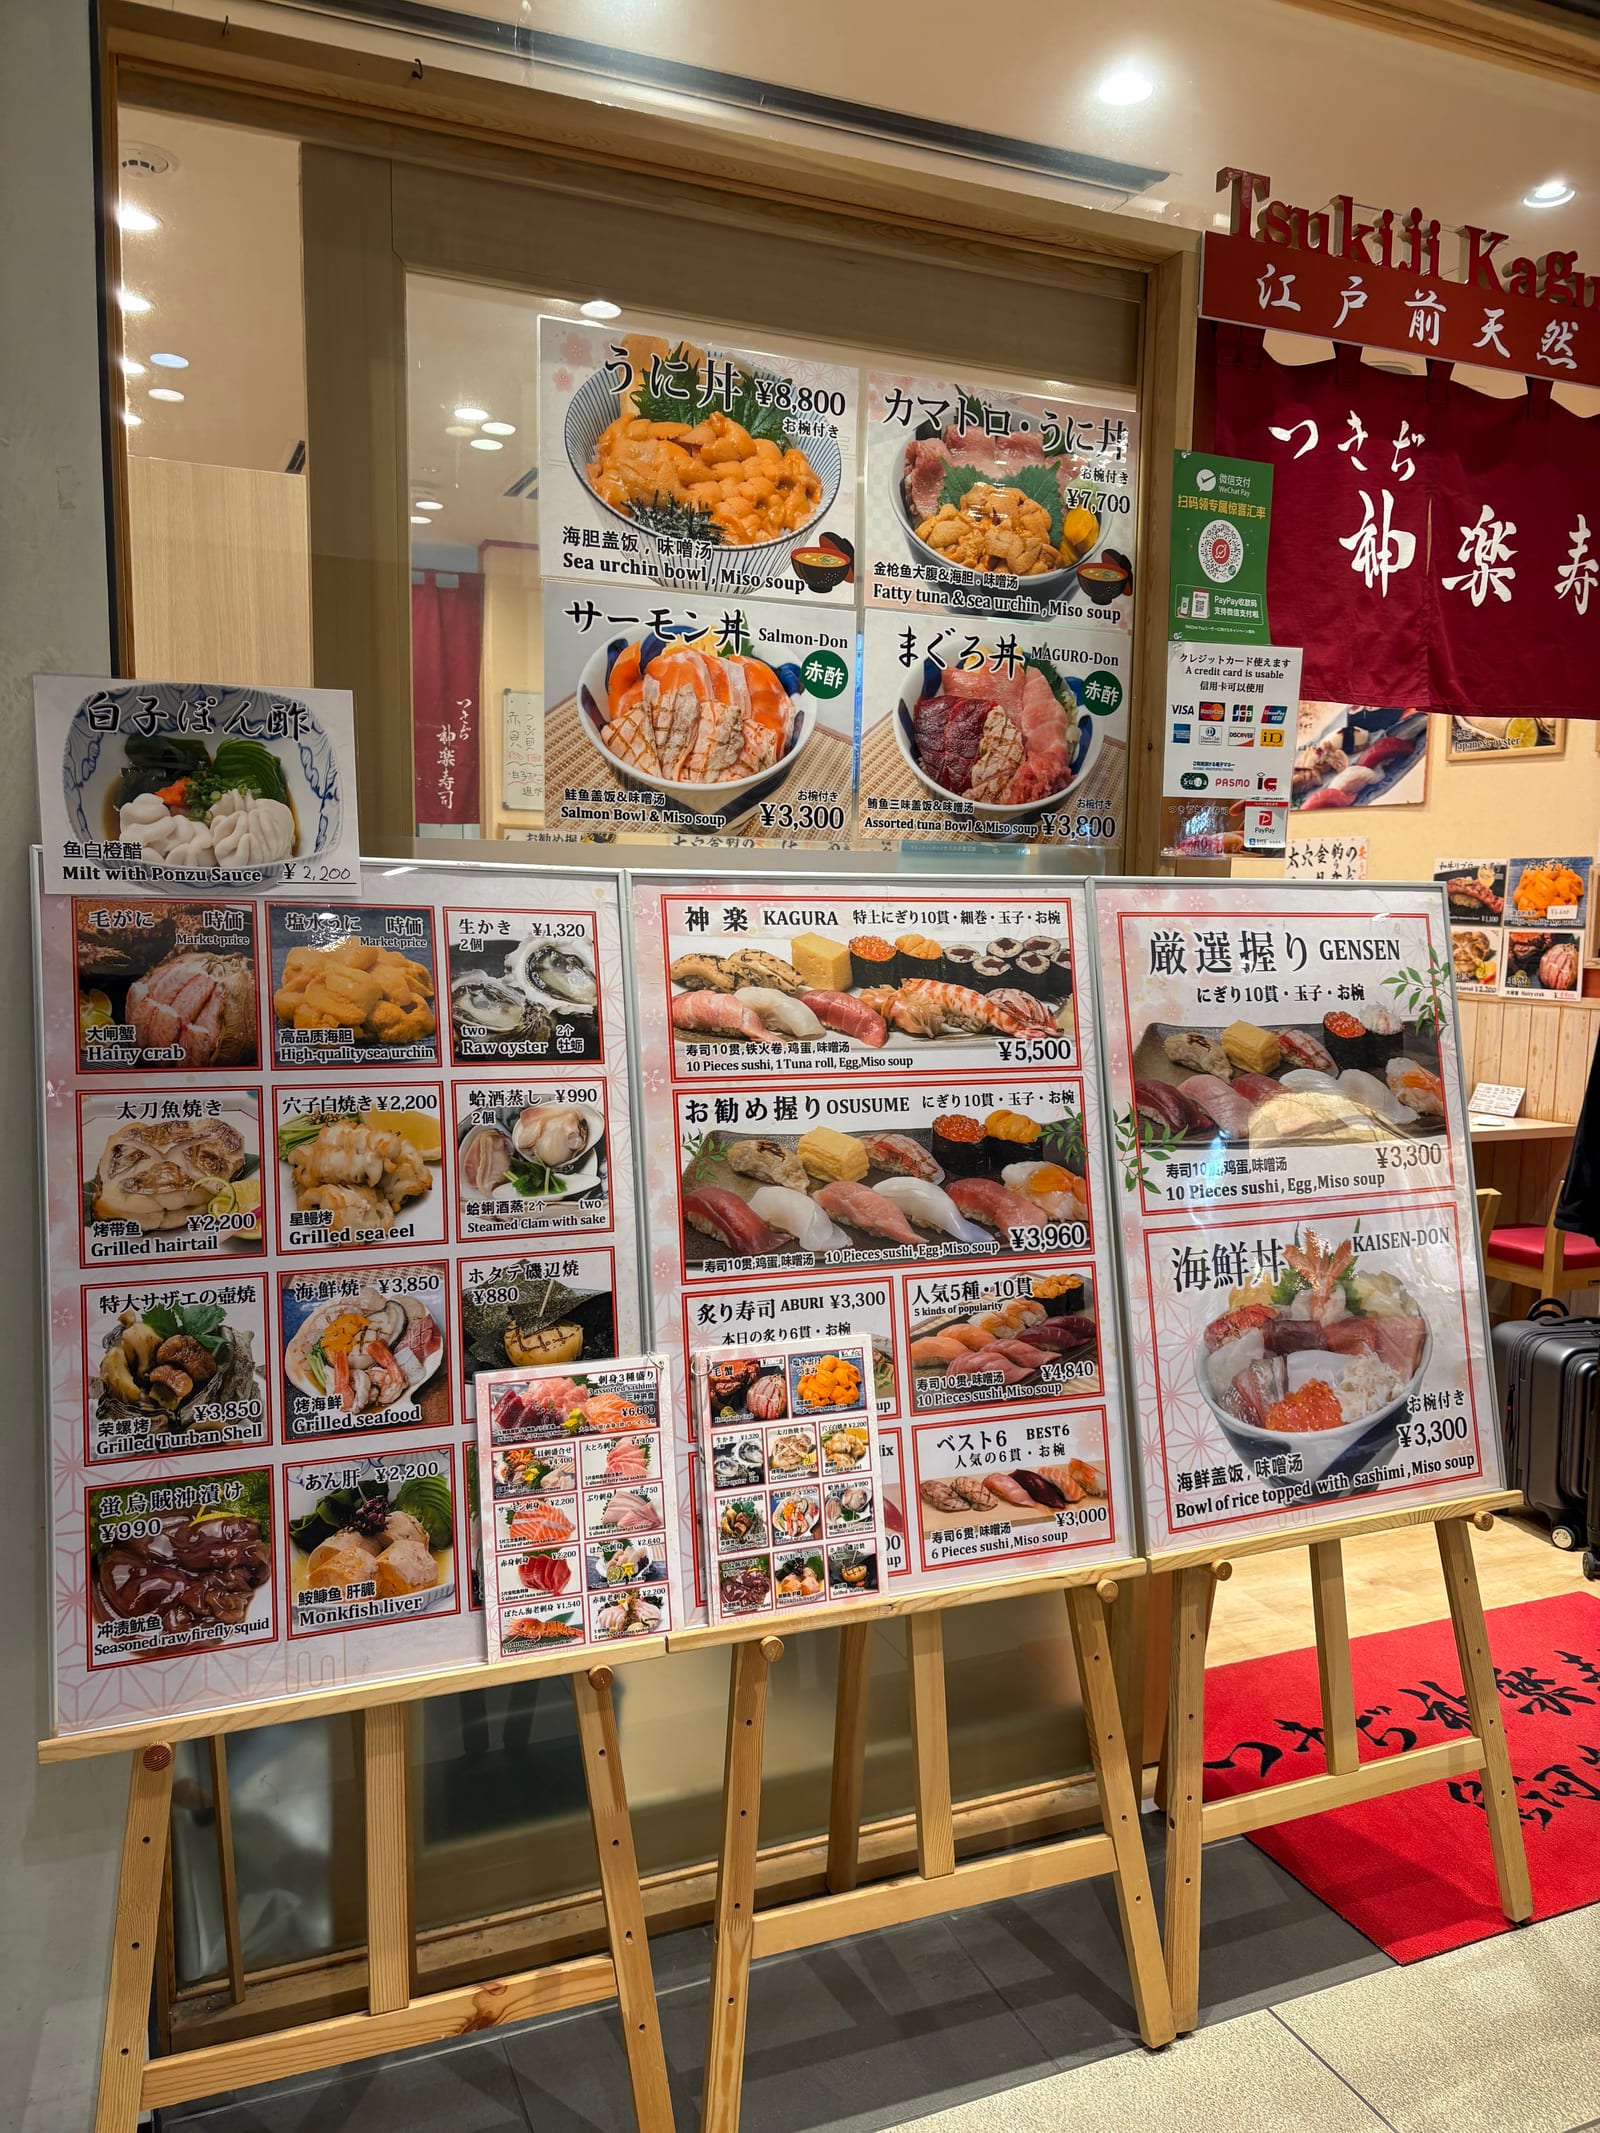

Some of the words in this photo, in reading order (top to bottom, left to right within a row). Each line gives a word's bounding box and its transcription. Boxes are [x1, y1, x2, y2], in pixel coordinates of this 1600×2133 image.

[1216, 167, 1443, 279] Tsukiji
[1257, 263, 1581, 371] 江戸前天然
[604, 344, 742, 411] うに丼
[755, 380, 846, 416] ¥8,800
[782, 419, 840, 439] お椀付き
[883, 387, 1129, 461] カマトロ・うに丼
[1268, 410, 1426, 483] つきぢ
[1219, 473, 1250, 487] 微信支付
[1066, 488, 1131, 515] ¥7,700
[1219, 486, 1239, 496] WeChat
[1240, 488, 1250, 499] Pay
[563, 553, 594, 571] Sea
[599, 556, 659, 577] urchin
[721, 571, 761, 588] Miso
[765, 575, 805, 594] soup
[873, 583, 911, 605] Fatty
[916, 589, 948, 605] tuna
[967, 595, 991, 609] sea
[1049, 598, 1083, 617] Miso
[1086, 604, 1121, 623] soup
[564, 600, 750, 656] サーモン丼
[758, 627, 849, 649] Salmon-Don
[898, 624, 1024, 680] まぐろ丼
[1031, 646, 1119, 667] MAGURO-Don
[805, 662, 845, 690] 赤酢
[1185, 666, 1192, 675] A
[1195, 667, 1220, 676] credit
[1223, 668, 1242, 677] card
[1245, 669, 1252, 678] is
[1255, 670, 1284, 680] usable
[1084, 681, 1119, 707] 赤酢
[1200, 681, 1264, 694] 信用卡可以使用
[86, 691, 312, 742] 白子ぽん酢
[1172, 704, 1195, 716] VISA
[1215, 777, 1250, 788] PASMO
[561, 806, 610, 822] Salmon
[613, 808, 646, 823] Bowl
[663, 810, 693, 824] Miso
[696, 813, 727, 829] soup
[760, 804, 844, 831] ¥3,300
[865, 816, 914, 831] Assorted
[917, 818, 941, 831] tuna
[944, 819, 972, 832] Bowl
[986, 821, 1011, 834] Miso
[1013, 824, 1038, 837] soup
[1041, 813, 1116, 839] ¥3,800
[62, 841, 143, 861] 鱼白橙醋
[62, 866, 101, 881] Milt
[105, 865, 148, 881] with
[152, 866, 207, 881] Ponzu
[211, 867, 262, 882] Sauce
[89, 909, 154, 929] 毛がに
[204, 911, 243, 931] 時価
[386, 916, 422, 936] 時価
[459, 919, 511, 935] 生かき
[532, 922, 585, 938] ¥1,320
[685, 906, 749, 933] 神楽
[763, 910, 839, 927] KAGURA
[176, 934, 219, 946] Market
[220, 935, 249, 947] price
[361, 936, 397, 948] Market
[400, 937, 427, 949] price
[460, 938, 483, 951] 2個
[1149, 930, 1310, 976] 厳選握り
[1319, 938, 1401, 961] GENSEN
[87, 1026, 135, 1042] 大闸蟹
[280, 1028, 353, 1044] 高品质海胆
[462, 1025, 486, 1036] two
[556, 1025, 574, 1037] 2个
[88, 1046, 142, 1063] Hairy
[145, 1045, 185, 1061] crab
[280, 1047, 364, 1063] High-quality
[367, 1048, 390, 1059] sea
[392, 1046, 433, 1060] urchin
[462, 1040, 497, 1055] Raw
[500, 1042, 548, 1058] oyster
[998, 1040, 1072, 1061] ¥5,500
[282, 1094, 373, 1115] 穴子白焼き
[377, 1094, 438, 1113] ¥2,200
[469, 1089, 542, 1108] 蛤酒蒸し
[555, 1089, 598, 1103] ¥990
[826, 1097, 910, 1115] OSUSUME
[116, 1100, 222, 1120] 太刀魚焼き
[472, 1111, 496, 1125] 2個
[1375, 1143, 1442, 1169] ¥3,300
[528, 1201, 546, 1213] 2个
[579, 1199, 602, 1210] two
[93, 1221, 142, 1238] 烤带鱼
[188, 1213, 255, 1233] ¥2,200
[467, 1221, 518, 1234] Steamed
[520, 1218, 550, 1231] Clam
[552, 1216, 578, 1229] with
[580, 1214, 606, 1226] sake
[289, 1228, 350, 1246] Grilled
[356, 1229, 384, 1242] sea
[389, 1224, 415, 1239] eel
[1010, 1225, 1086, 1250] ¥3,960
[91, 1240, 151, 1258] Grilled
[155, 1236, 218, 1254] hairtail
[1171, 1238, 1286, 1293] 海鮮丼
[1352, 1227, 1451, 1253] KAISEN-DON
[378, 1275, 440, 1295] ¥3,850
[473, 1287, 519, 1305] ¥880
[697, 1298, 776, 1326] 炙り寿司
[780, 1297, 824, 1313] ABURI
[830, 1291, 886, 1311] ¥3,300
[914, 1306, 920, 1317] 5
[922, 1304, 944, 1317] kinds
[946, 1304, 956, 1316] of
[957, 1301, 1003, 1317] popularity
[1040, 1360, 1094, 1382] ¥4,840
[194, 1401, 261, 1422] ¥3,850
[622, 1405, 656, 1418] ¥6,600
[1408, 1390, 1465, 1413] お椀付き
[293, 1413, 351, 1433] Grilled
[357, 1406, 421, 1427] seafood
[97, 1435, 154, 1455] Grilled
[158, 1430, 220, 1449] Turban
[223, 1424, 262, 1440] Shell
[936, 1429, 1008, 1452] ベスト6
[1026, 1425, 1071, 1440] BEST6
[1397, 1416, 1468, 1448] ¥3,300
[305, 1468, 361, 1491] あん肝
[375, 1462, 439, 1484] ¥2,200
[1176, 1498, 1212, 1519] Bowl
[1215, 1494, 1230, 1511] of
[1231, 1491, 1260, 1508] rice
[1262, 1481, 1312, 1507] topped
[1316, 1475, 1350, 1493] with
[1444, 1454, 1475, 1472] soup
[1055, 1507, 1107, 1527] ¥3,000
[100, 1519, 161, 1543] ¥990
[299, 1602, 379, 1627] Monkfish
[383, 1597, 422, 1614] liver
[94, 1638, 159, 1656] Seasoned
[191, 1623, 232, 1643] firefly
[234, 1618, 270, 1636] squid
